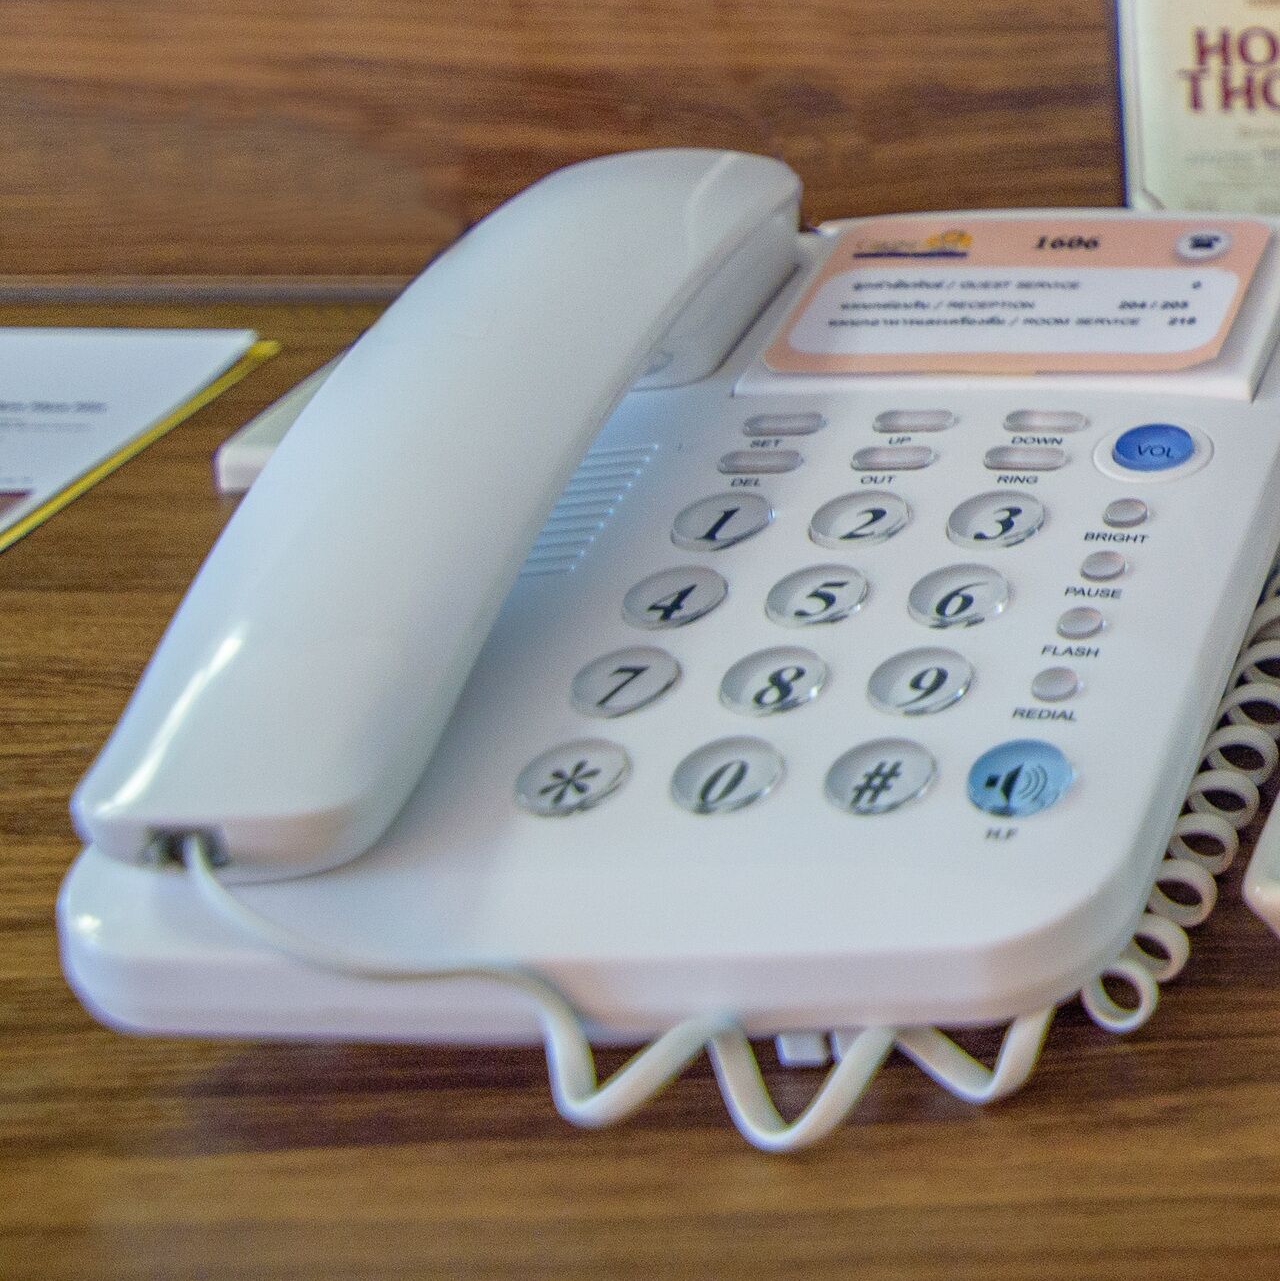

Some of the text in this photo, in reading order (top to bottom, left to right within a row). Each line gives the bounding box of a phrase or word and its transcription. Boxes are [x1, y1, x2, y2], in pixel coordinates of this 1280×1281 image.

[749, 438, 782, 449] SET
[888, 436, 911, 446] UP
[1010, 435, 1064, 447] DOWN
[1135, 444, 1174, 459] VOL
[730, 477, 761, 488] DEL
[860, 474, 896, 486] OUT
[996, 474, 1039, 486] RING
[695, 506, 741, 541] 1
[839, 507, 887, 541] 2
[973, 506, 1022, 541] 3
[1083, 531, 1149, 545] BRIGHT
[794, 580, 849, 617] 5
[935, 581, 989, 618] 6
[1064, 586, 1123, 600] PAUSE
[647, 584, 698, 621] 4
[1041, 644, 1100, 658] FLASH
[596, 665, 652, 708] 7
[753, 665, 806, 708] 8
[896, 666, 948, 708] 9
[1011, 707, 1077, 722] REDIAL
[701, 760, 749, 804] 0
